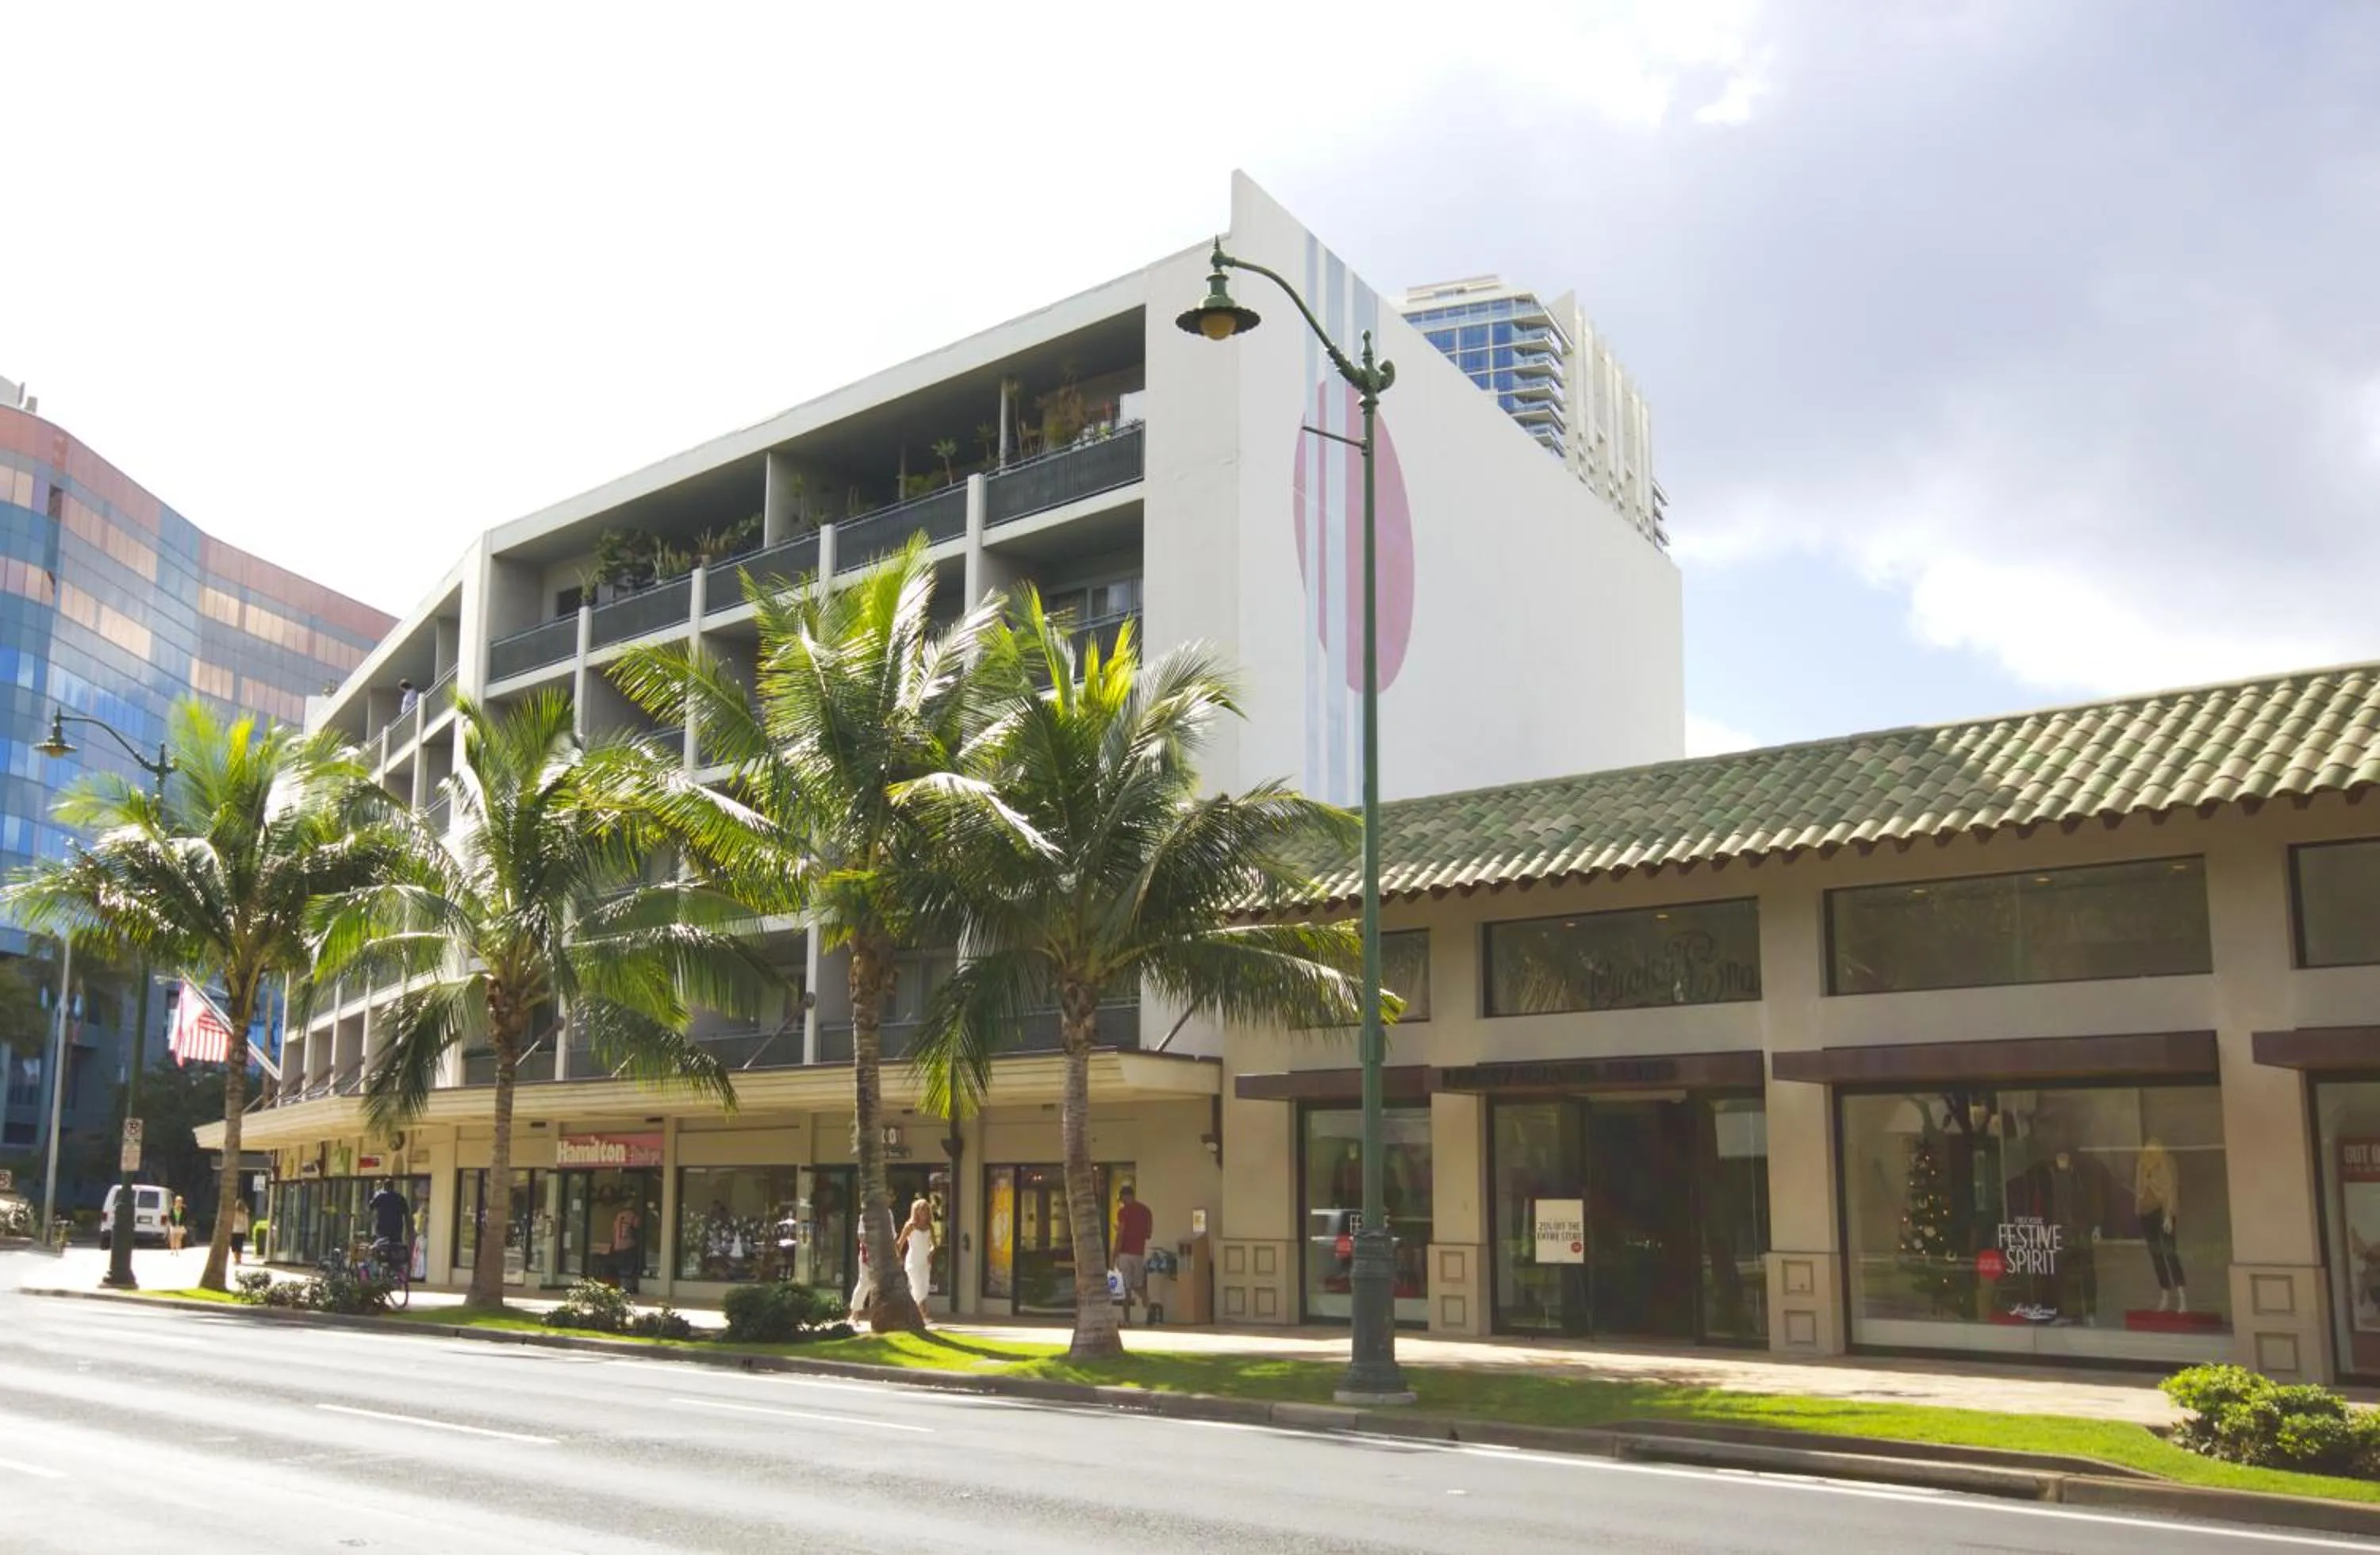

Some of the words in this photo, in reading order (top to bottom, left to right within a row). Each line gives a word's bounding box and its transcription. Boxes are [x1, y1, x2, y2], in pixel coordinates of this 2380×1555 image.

[556, 1135, 625, 1164] Hamilton
[1998, 1223, 2063, 1250] FESTIVE
[2006, 1249, 2056, 1275] SPIRIT
